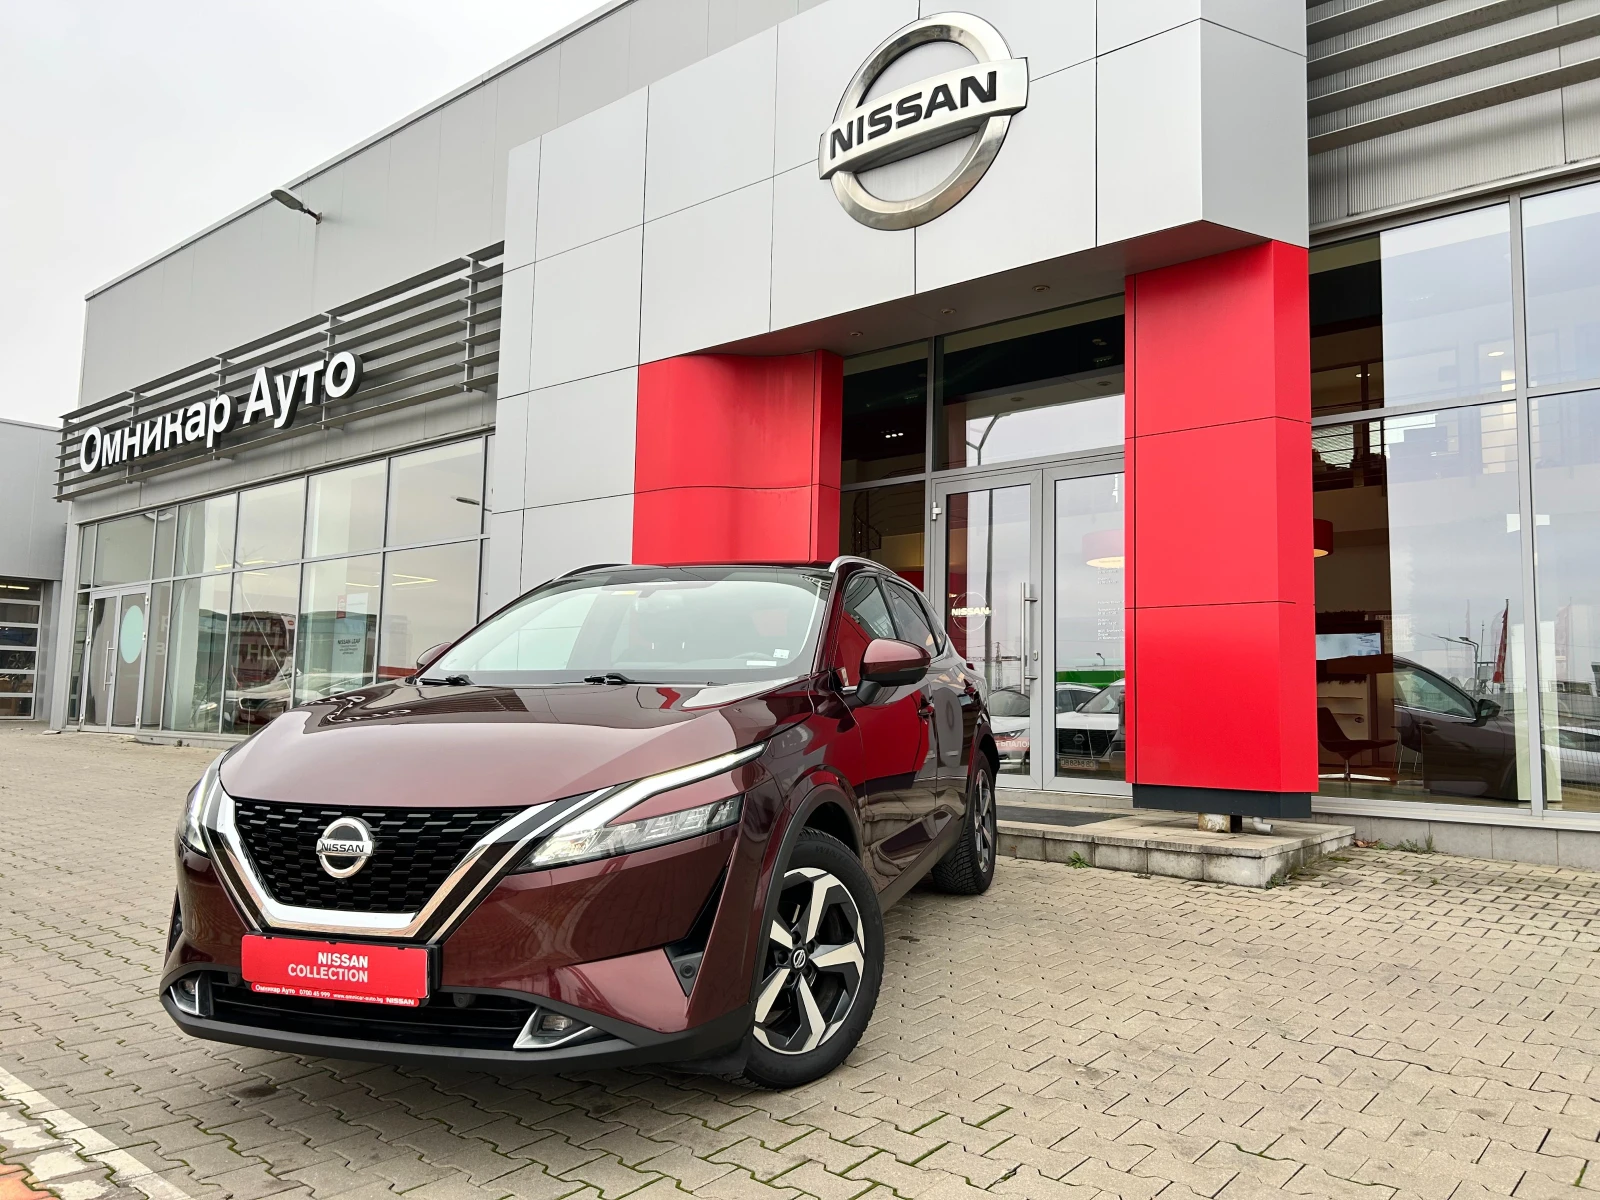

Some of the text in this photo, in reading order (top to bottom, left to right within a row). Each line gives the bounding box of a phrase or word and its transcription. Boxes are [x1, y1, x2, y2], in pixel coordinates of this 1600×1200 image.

[829, 70, 997, 161] NISSAN
[79, 351, 358, 474] Омникар Ауто
[951, 607, 990, 616] NISSAN
[321, 843, 365, 853] NISSAN
[317, 952, 368, 968] NISSAN
[287, 963, 368, 983] COLLECTION
[255, 984, 281, 994] Омникар
[281, 986, 296, 995] Ауто
[332, 993, 384, 1004] www.omnicar-auto.bg
[385, 997, 415, 1005] NISSAN
